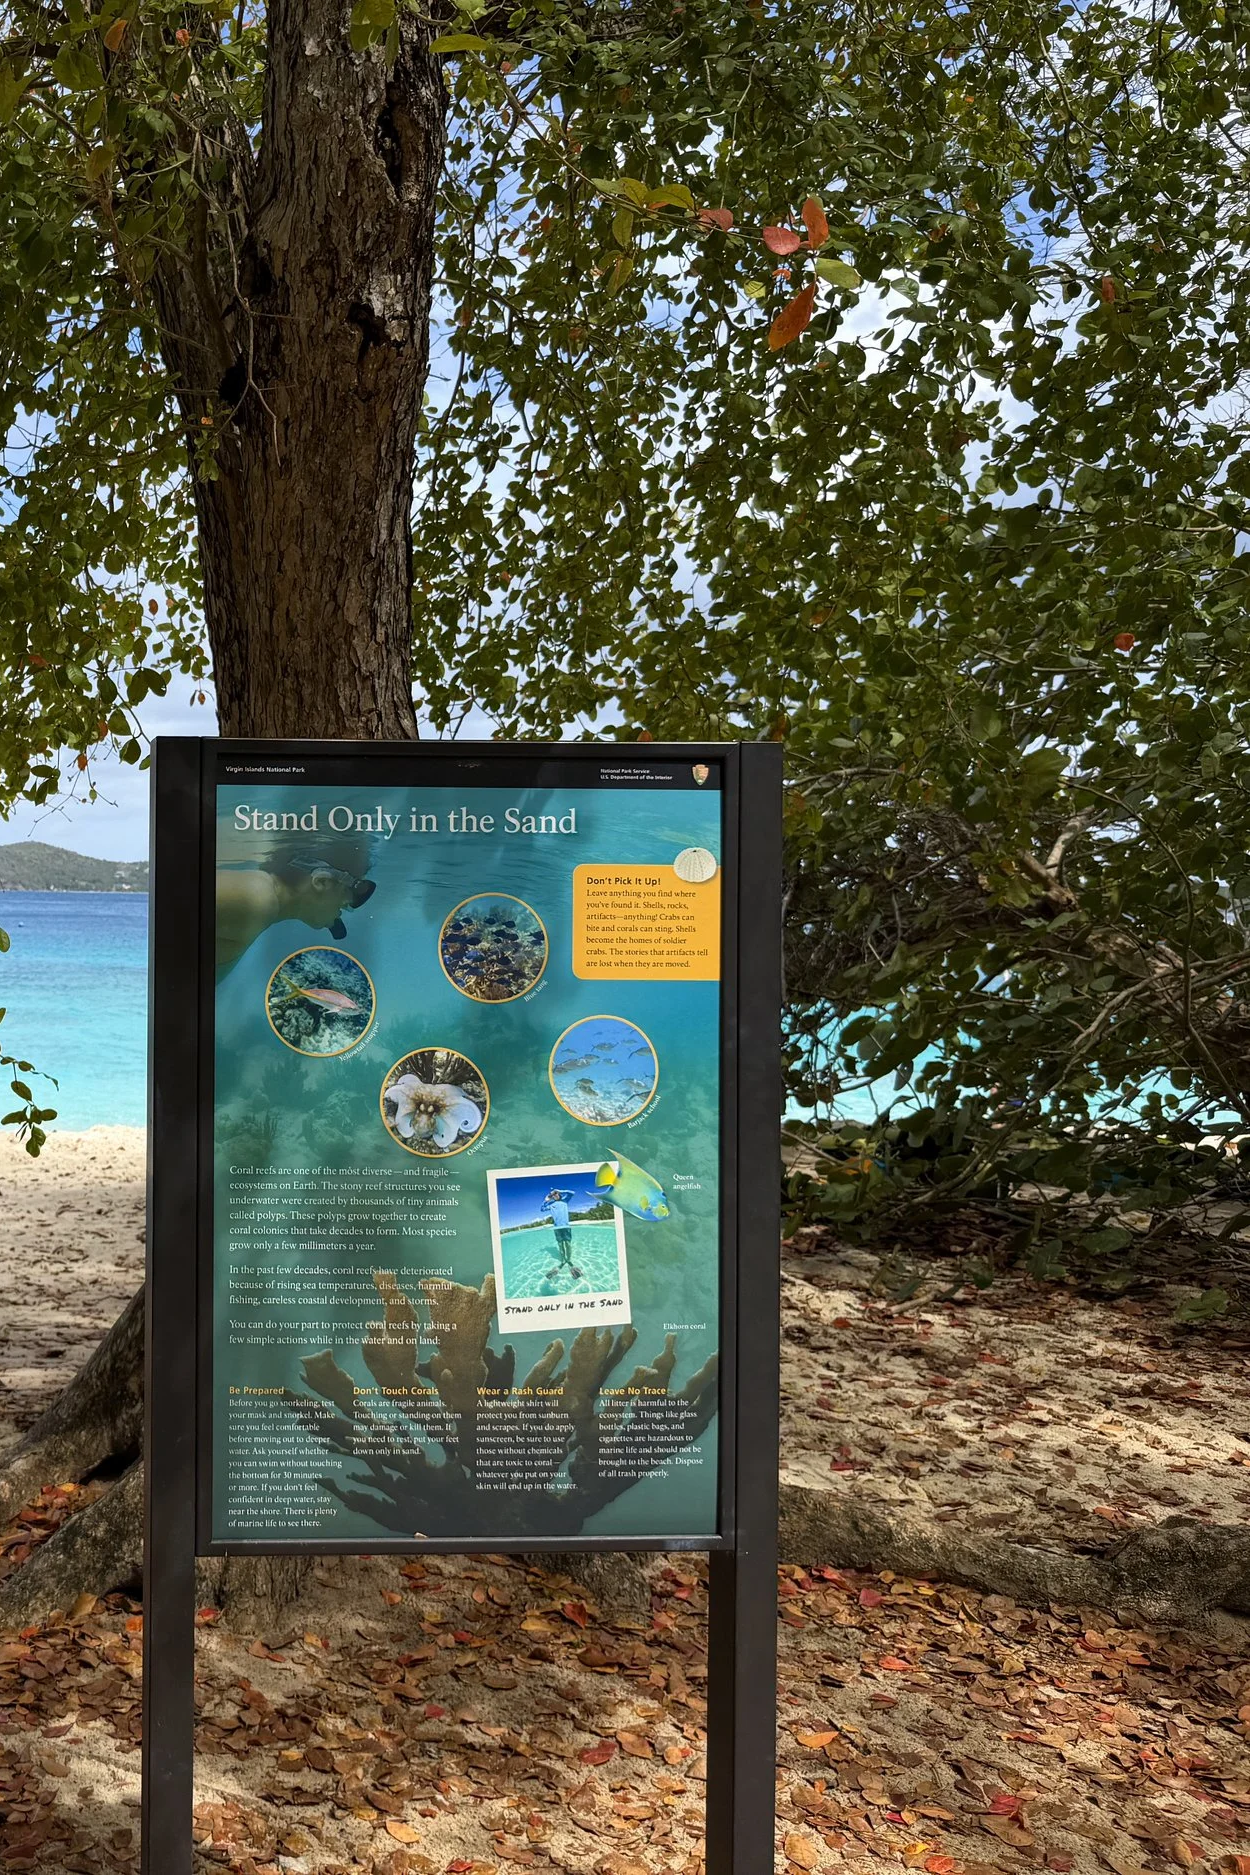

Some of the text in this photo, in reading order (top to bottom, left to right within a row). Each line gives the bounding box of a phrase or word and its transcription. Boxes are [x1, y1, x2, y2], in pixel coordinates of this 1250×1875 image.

[225, 765, 243, 773] Virgin
[234, 804, 577, 839] Stand Only in the Sand
[586, 876, 660, 887] Don't Pick It Up!
[608, 889, 642, 899] anything
[642, 891, 656, 899] you
[657, 889, 672, 897] find
[585, 900, 609, 910] you've
[610, 900, 632, 908] found
[642, 901, 666, 909] Shells,
[666, 901, 689, 910] rocks,
[523, 990, 537, 1002] Blue
[466, 1136, 488, 1156] Octopus
[672, 1173, 694, 1181] Queen
[672, 1182, 701, 1190] angelfish
[229, 1210, 447, 1222] called polyps. These polyps grow together to create
[504, 1298, 623, 1314] STAND ONLY IN THE SAND
[229, 1319, 246, 1328] You
[265, 1319, 277, 1328] do
[278, 1322, 300, 1331] your
[301, 1321, 319, 1331] part
[321, 1321, 330, 1329] to
[332, 1321, 363, 1331] protect
[364, 1319, 386, 1332] coral
[388, 1320, 409, 1330] reefs
[410, 1320, 422, 1332] by
[423, 1320, 450, 1332] taking
[451, 1322, 457, 1330] a
[229, 1386, 284, 1396] Be Prepared
[353, 1386, 439, 1395] Don't Touch Corals
[476, 1387, 501, 1395] Wear
[511, 1386, 533, 1395] Rash
[535, 1386, 563, 1395] Guard
[599, 1386, 666, 1395] Leave No Trace
